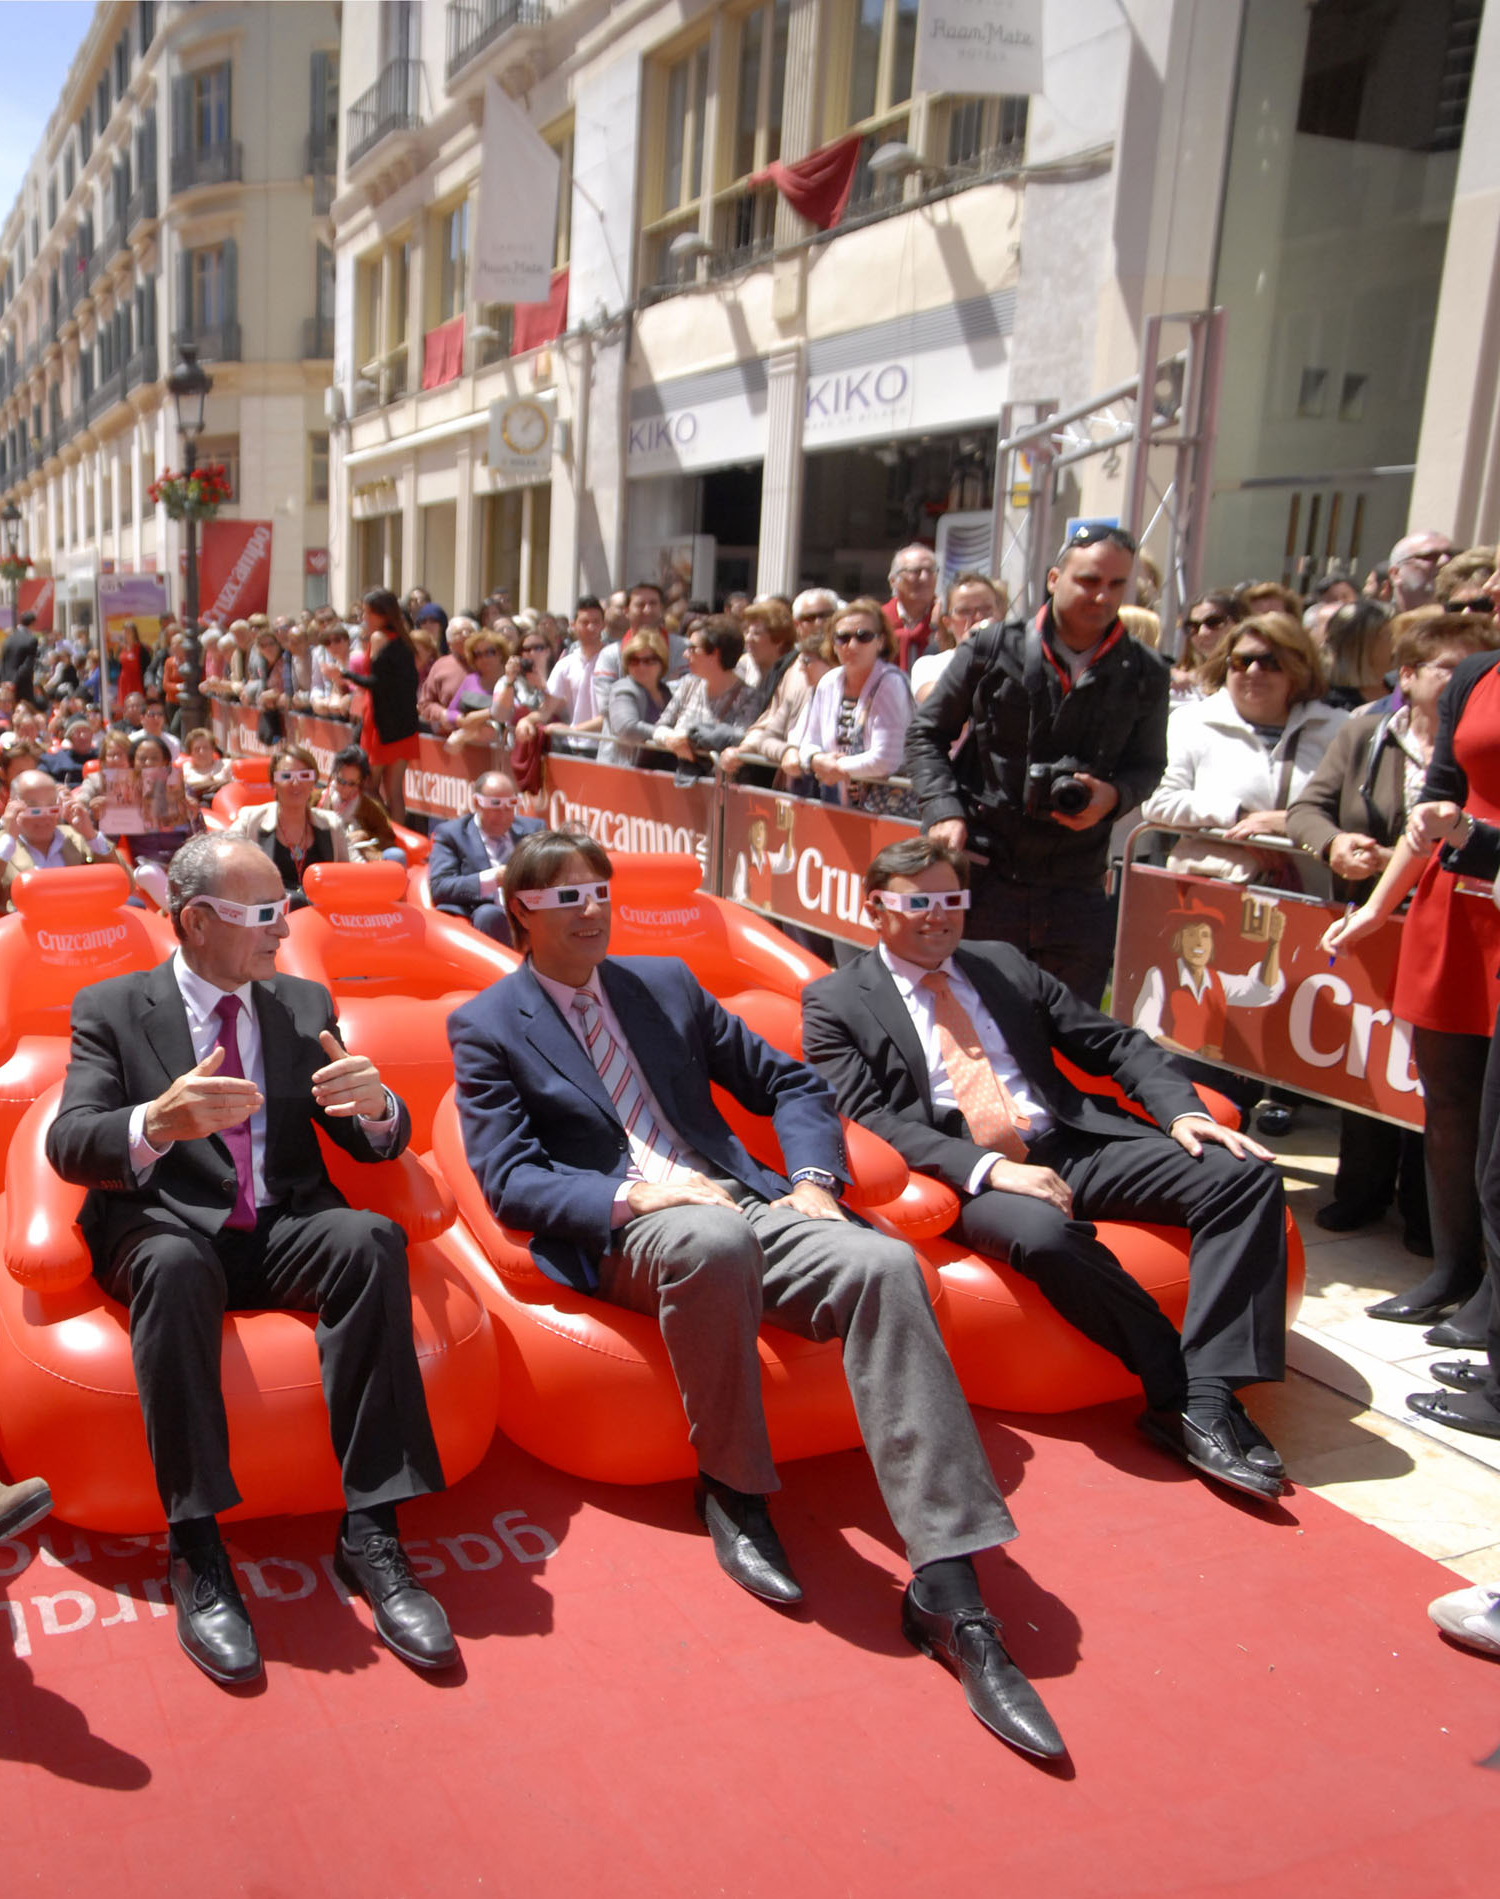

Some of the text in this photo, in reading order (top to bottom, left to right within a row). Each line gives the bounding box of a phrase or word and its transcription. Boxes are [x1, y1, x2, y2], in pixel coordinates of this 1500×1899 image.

[805, 364, 908, 418] KIKO
[629, 411, 697, 455] KIKO
[405, 768, 477, 817] uzcampo
[37, 924, 127, 951] Cruzcampo
[619, 904, 701, 927] Cruzcampo
